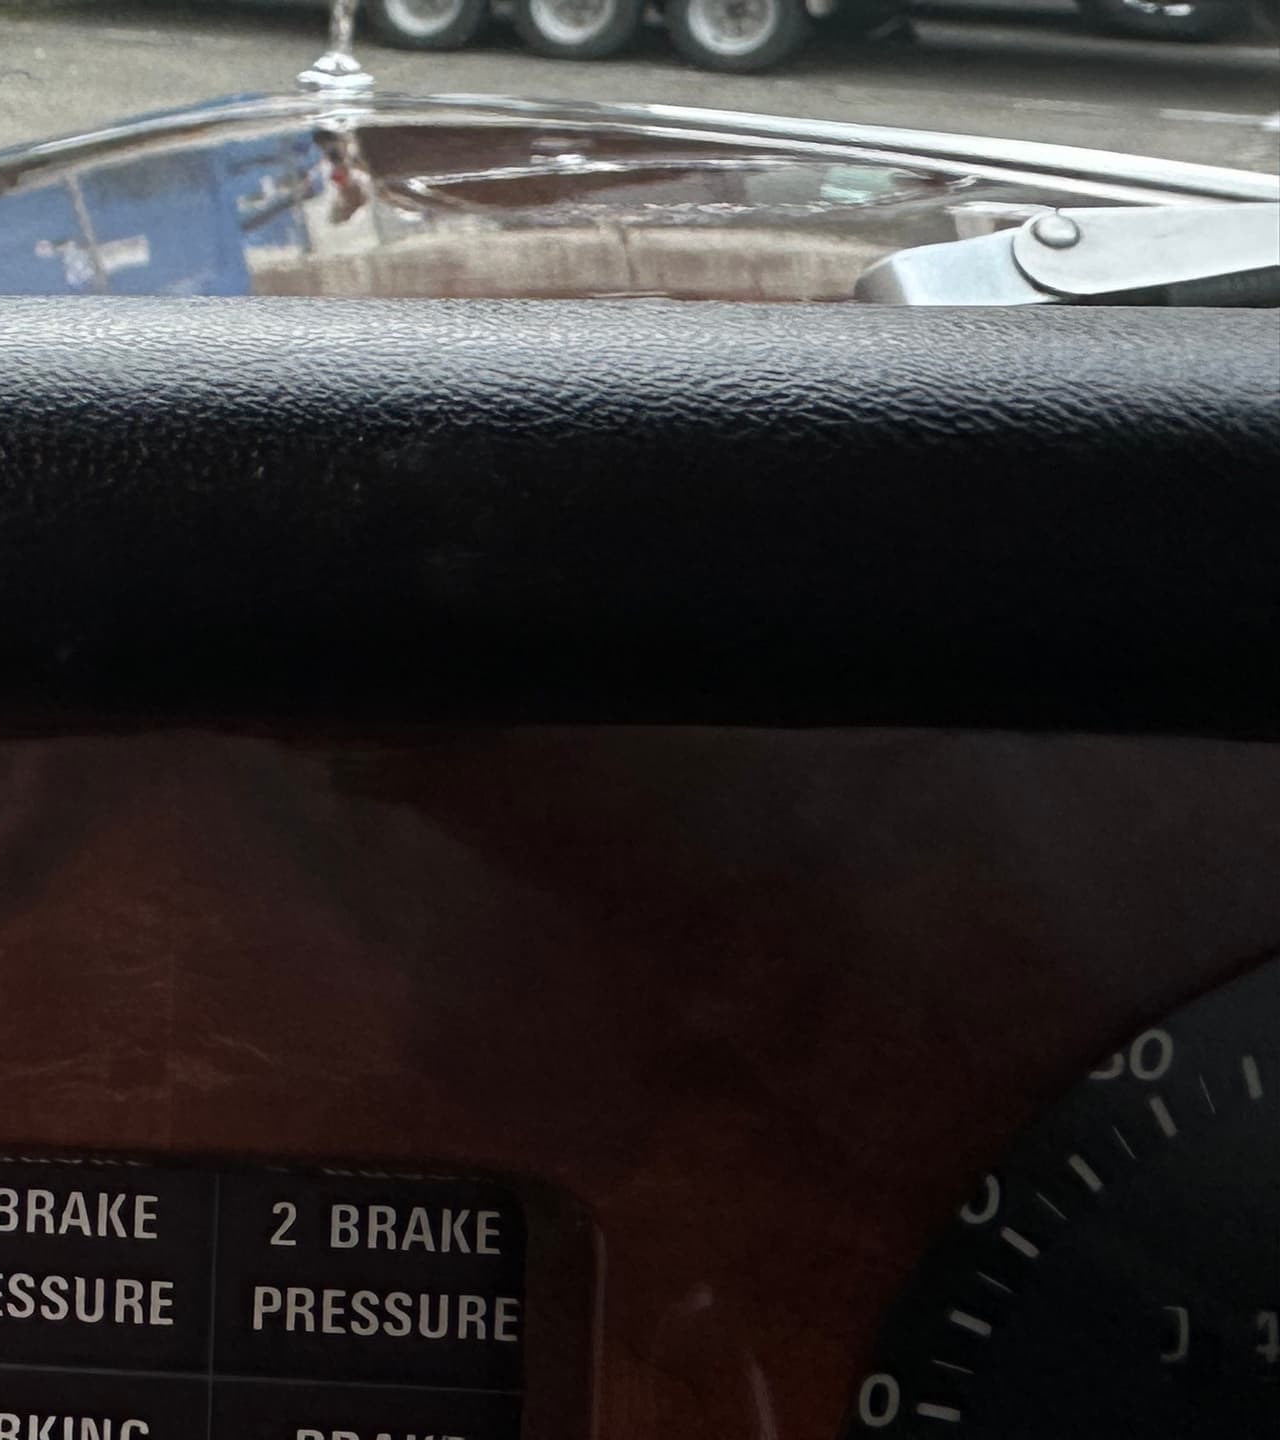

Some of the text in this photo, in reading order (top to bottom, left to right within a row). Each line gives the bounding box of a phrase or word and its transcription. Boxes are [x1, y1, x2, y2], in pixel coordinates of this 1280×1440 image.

[270, 1201, 502, 1255] 2 BRAKE
[252, 1286, 519, 1342] PRESSURE
